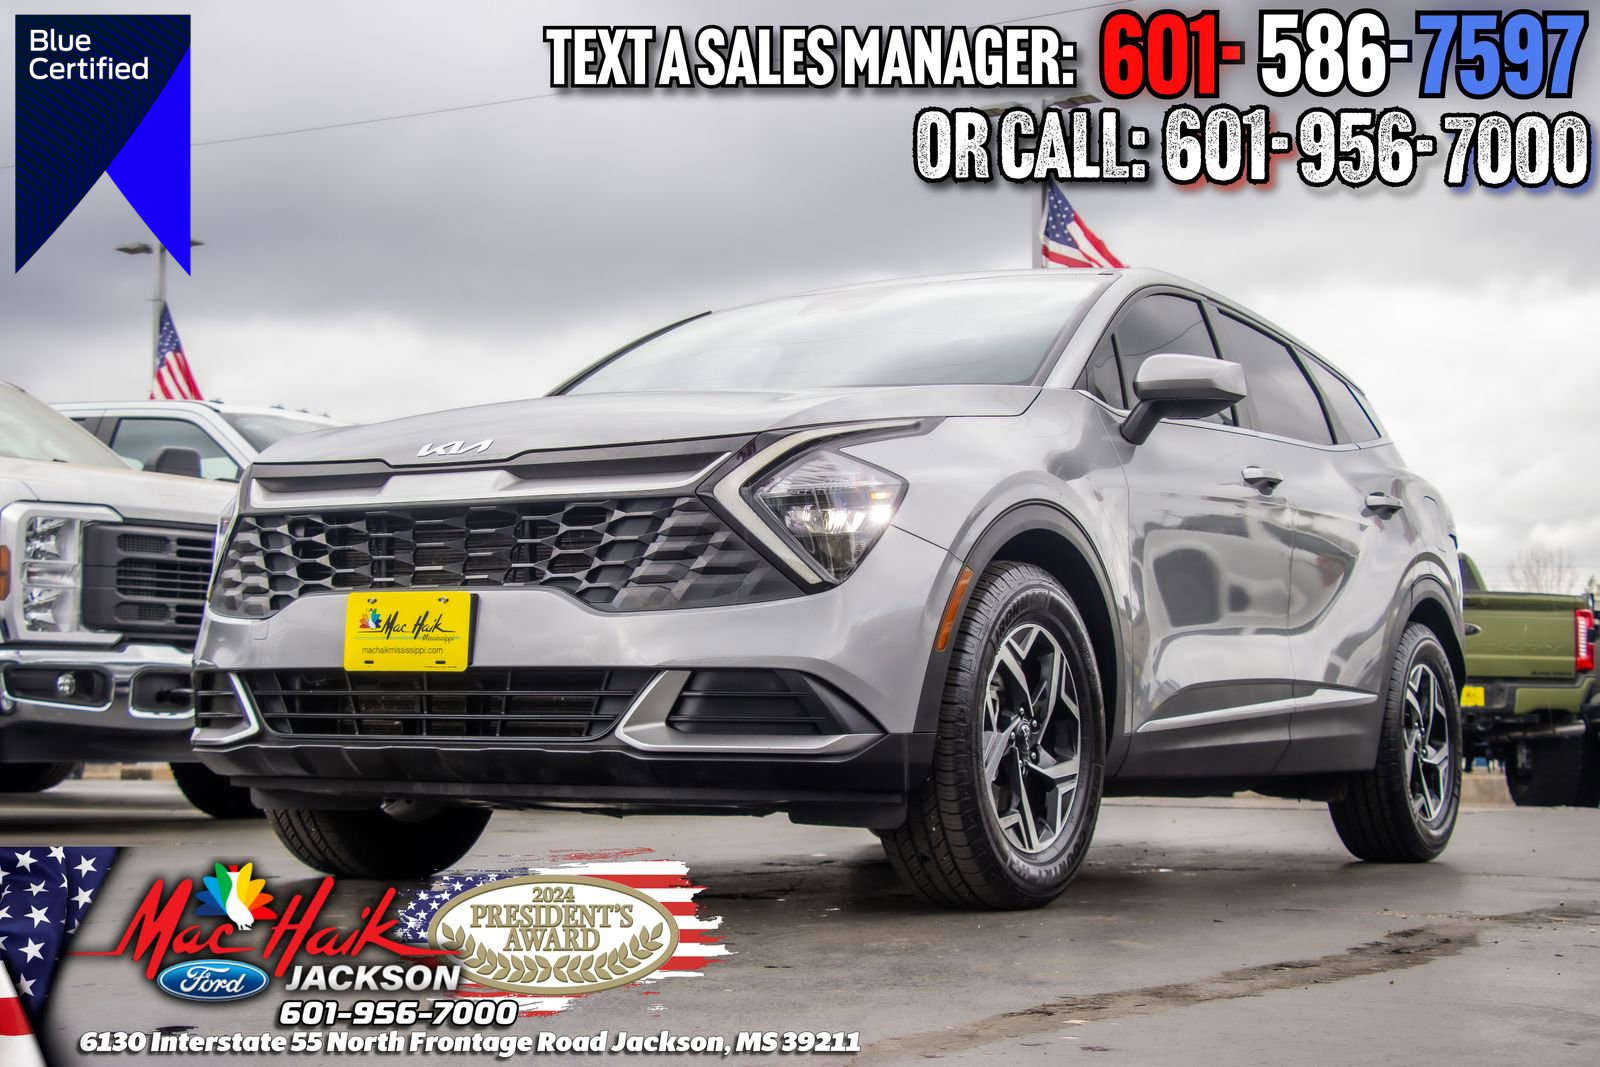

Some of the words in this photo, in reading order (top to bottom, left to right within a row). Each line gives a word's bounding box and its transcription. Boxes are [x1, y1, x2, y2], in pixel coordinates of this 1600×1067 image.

[416, 439, 494, 458] KIA
[379, 610, 408, 640] Mac
[411, 610, 453, 640] Haik
[361, 646, 444, 656] machaikmississippi.com
